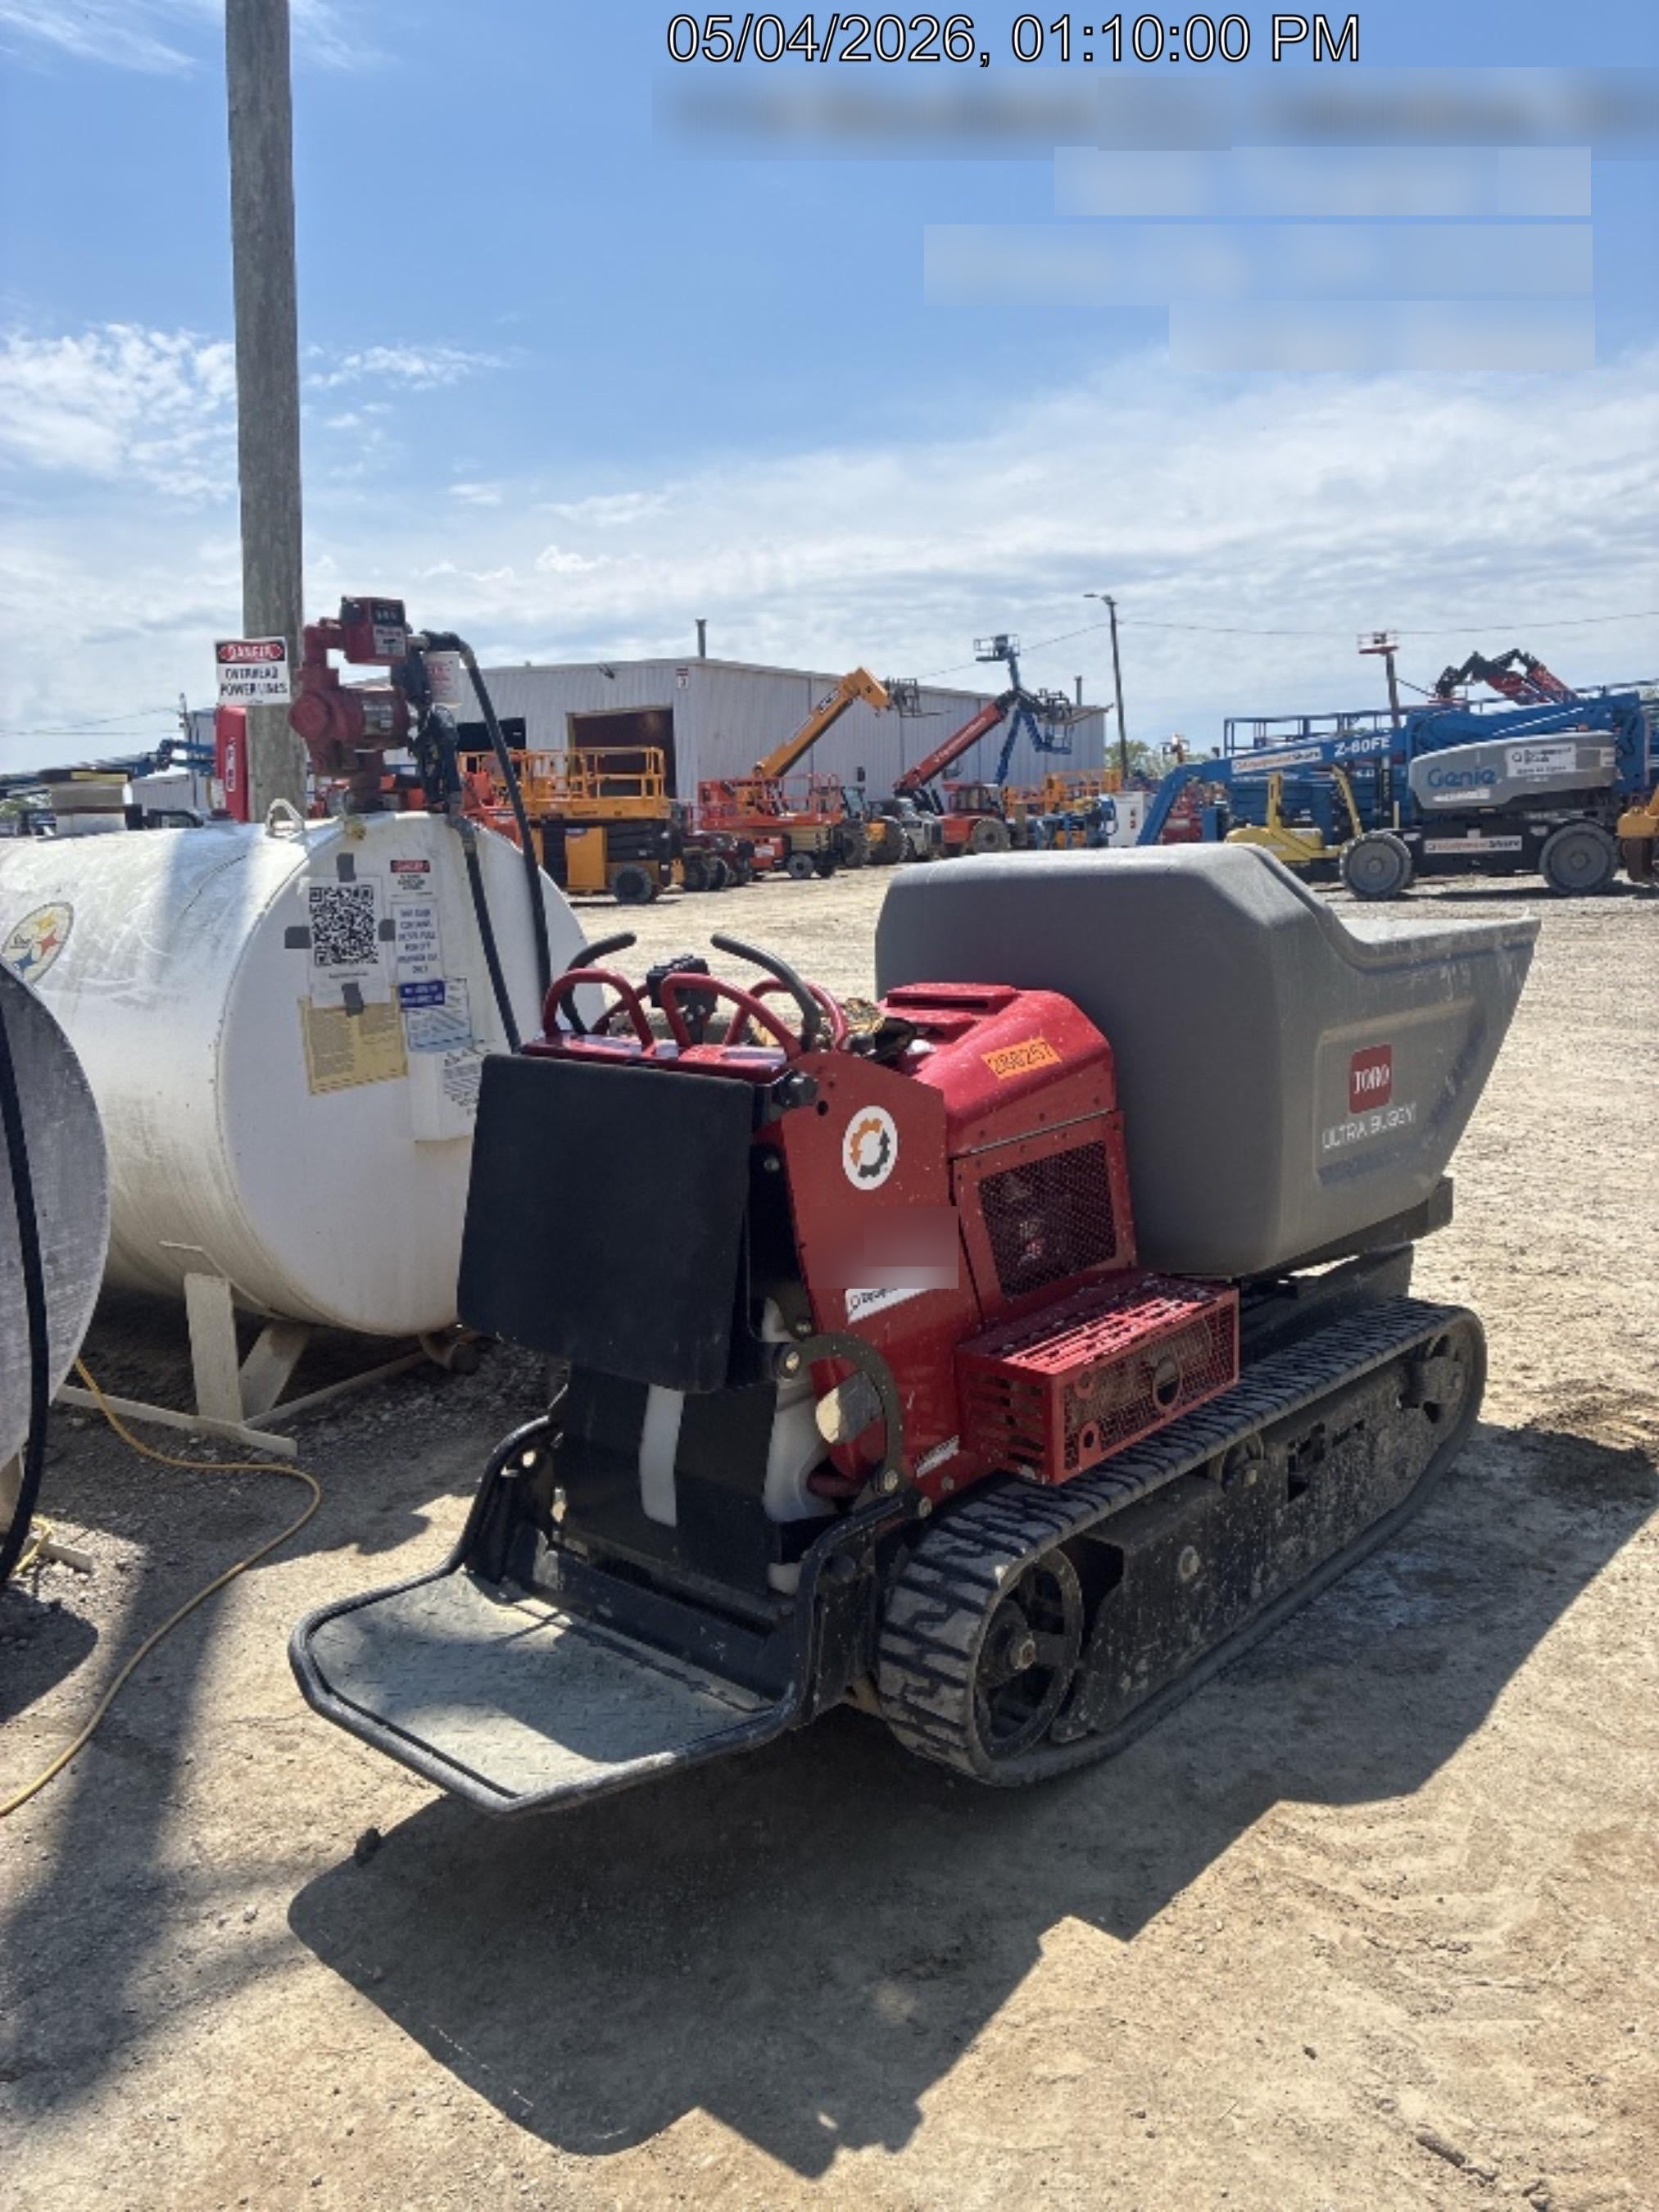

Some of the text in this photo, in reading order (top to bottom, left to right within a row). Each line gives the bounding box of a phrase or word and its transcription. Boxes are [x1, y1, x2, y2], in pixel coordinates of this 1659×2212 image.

[225, 666, 278, 679] OVERHEAD
[1335, 737, 1390, 758] Z-60FE
[1427, 765, 1495, 788] Genie
[1353, 1063, 1390, 1095] TORO
[1322, 1121, 1367, 1149] ULTRA
